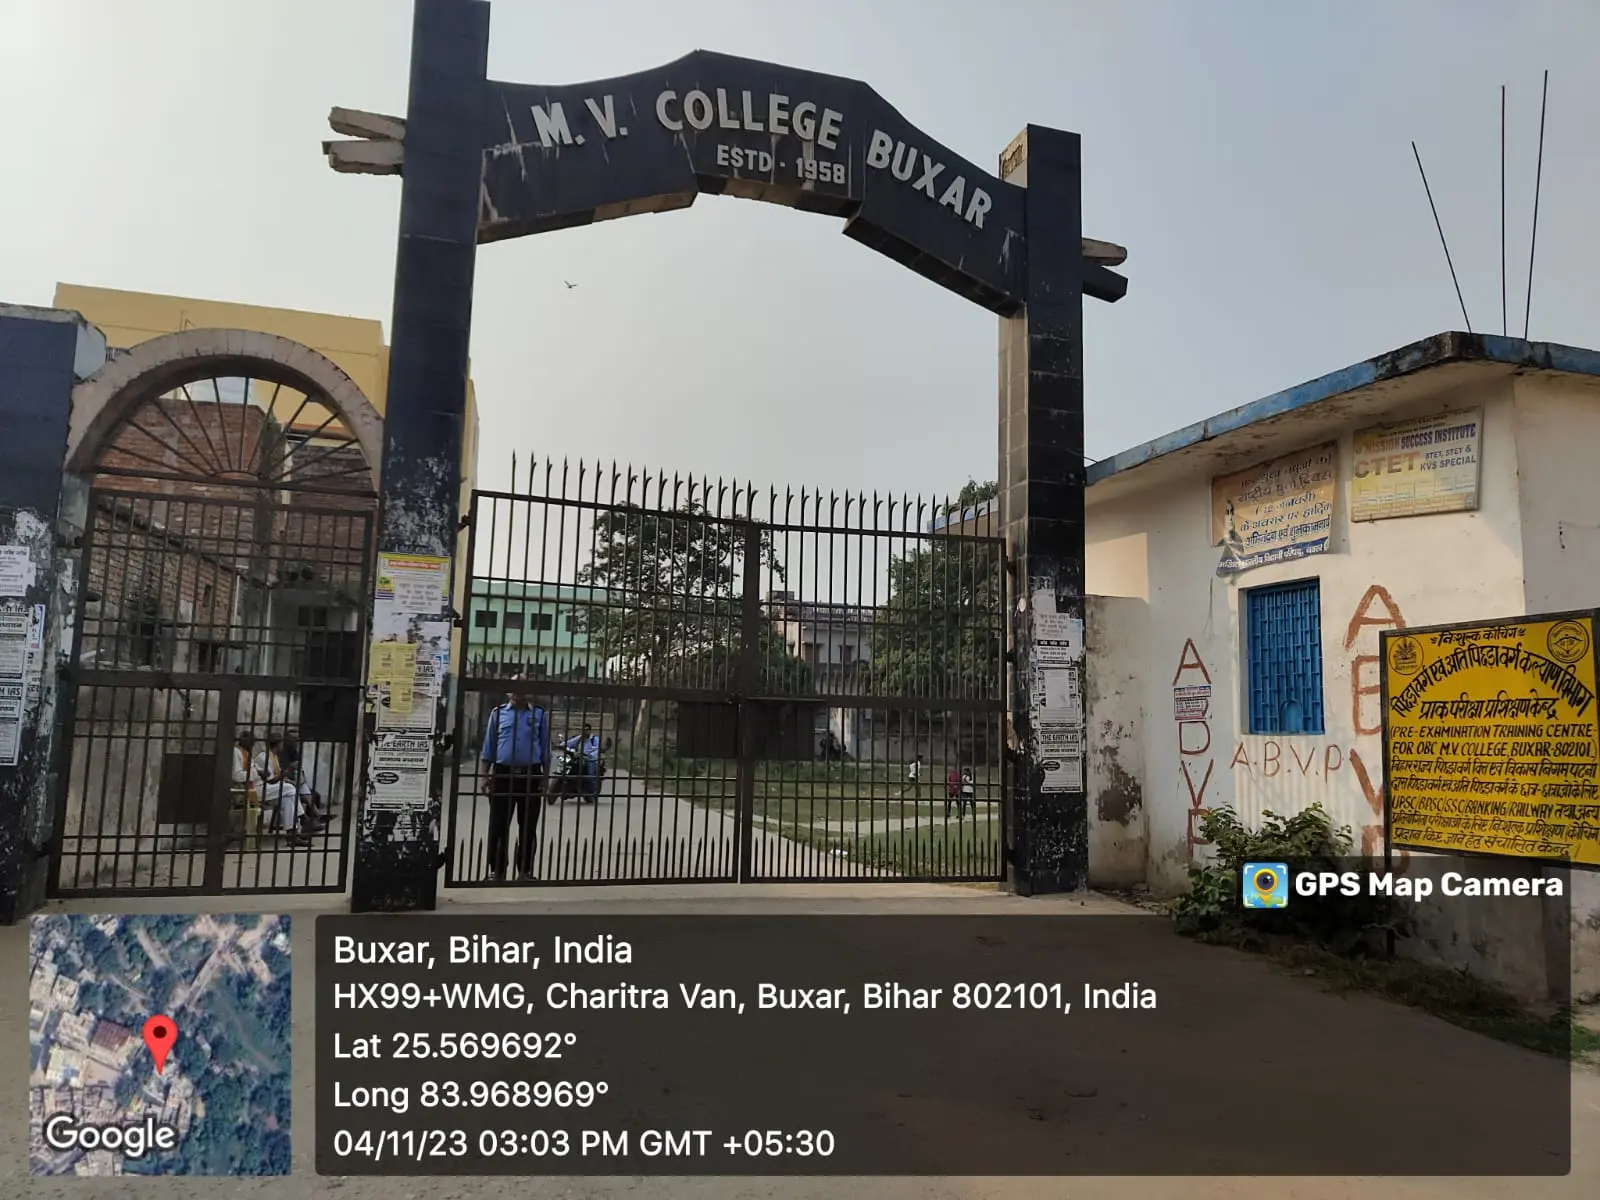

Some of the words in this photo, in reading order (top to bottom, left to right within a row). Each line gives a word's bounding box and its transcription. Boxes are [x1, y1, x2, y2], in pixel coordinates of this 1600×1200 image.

[531, 102, 585, 148] M.
[584, 95, 628, 138] V.
[655, 88, 843, 150] COLLEGE
[866, 129, 993, 229] BUXAR
[796, 158, 845, 184] 1958
[1401, 431, 1433, 449] SUCCESS
[1434, 423, 1476, 443] INSTITUTE
[1354, 451, 1420, 478] CTET
[1421, 461, 1437, 472] KVS
[1439, 456, 1476, 469] SPECIAL
[1278, 524, 1290, 539] एवं
[1412, 665, 1434, 693] वर्ग
[1429, 656, 1448, 682] एवं
[1445, 647, 1469, 675] अति
[1500, 641, 1522, 670] वर्ग
[1519, 650, 1563, 690] कल्याण
[1556, 663, 1595, 718] विभाग
[1493, 724, 1543, 738] TRAINING
[392, 740, 415, 748] EARTH
[1392, 741, 1414, 755] FOR
[1416, 741, 1438, 755] OBC
[1570, 763, 1598, 778] पटना
